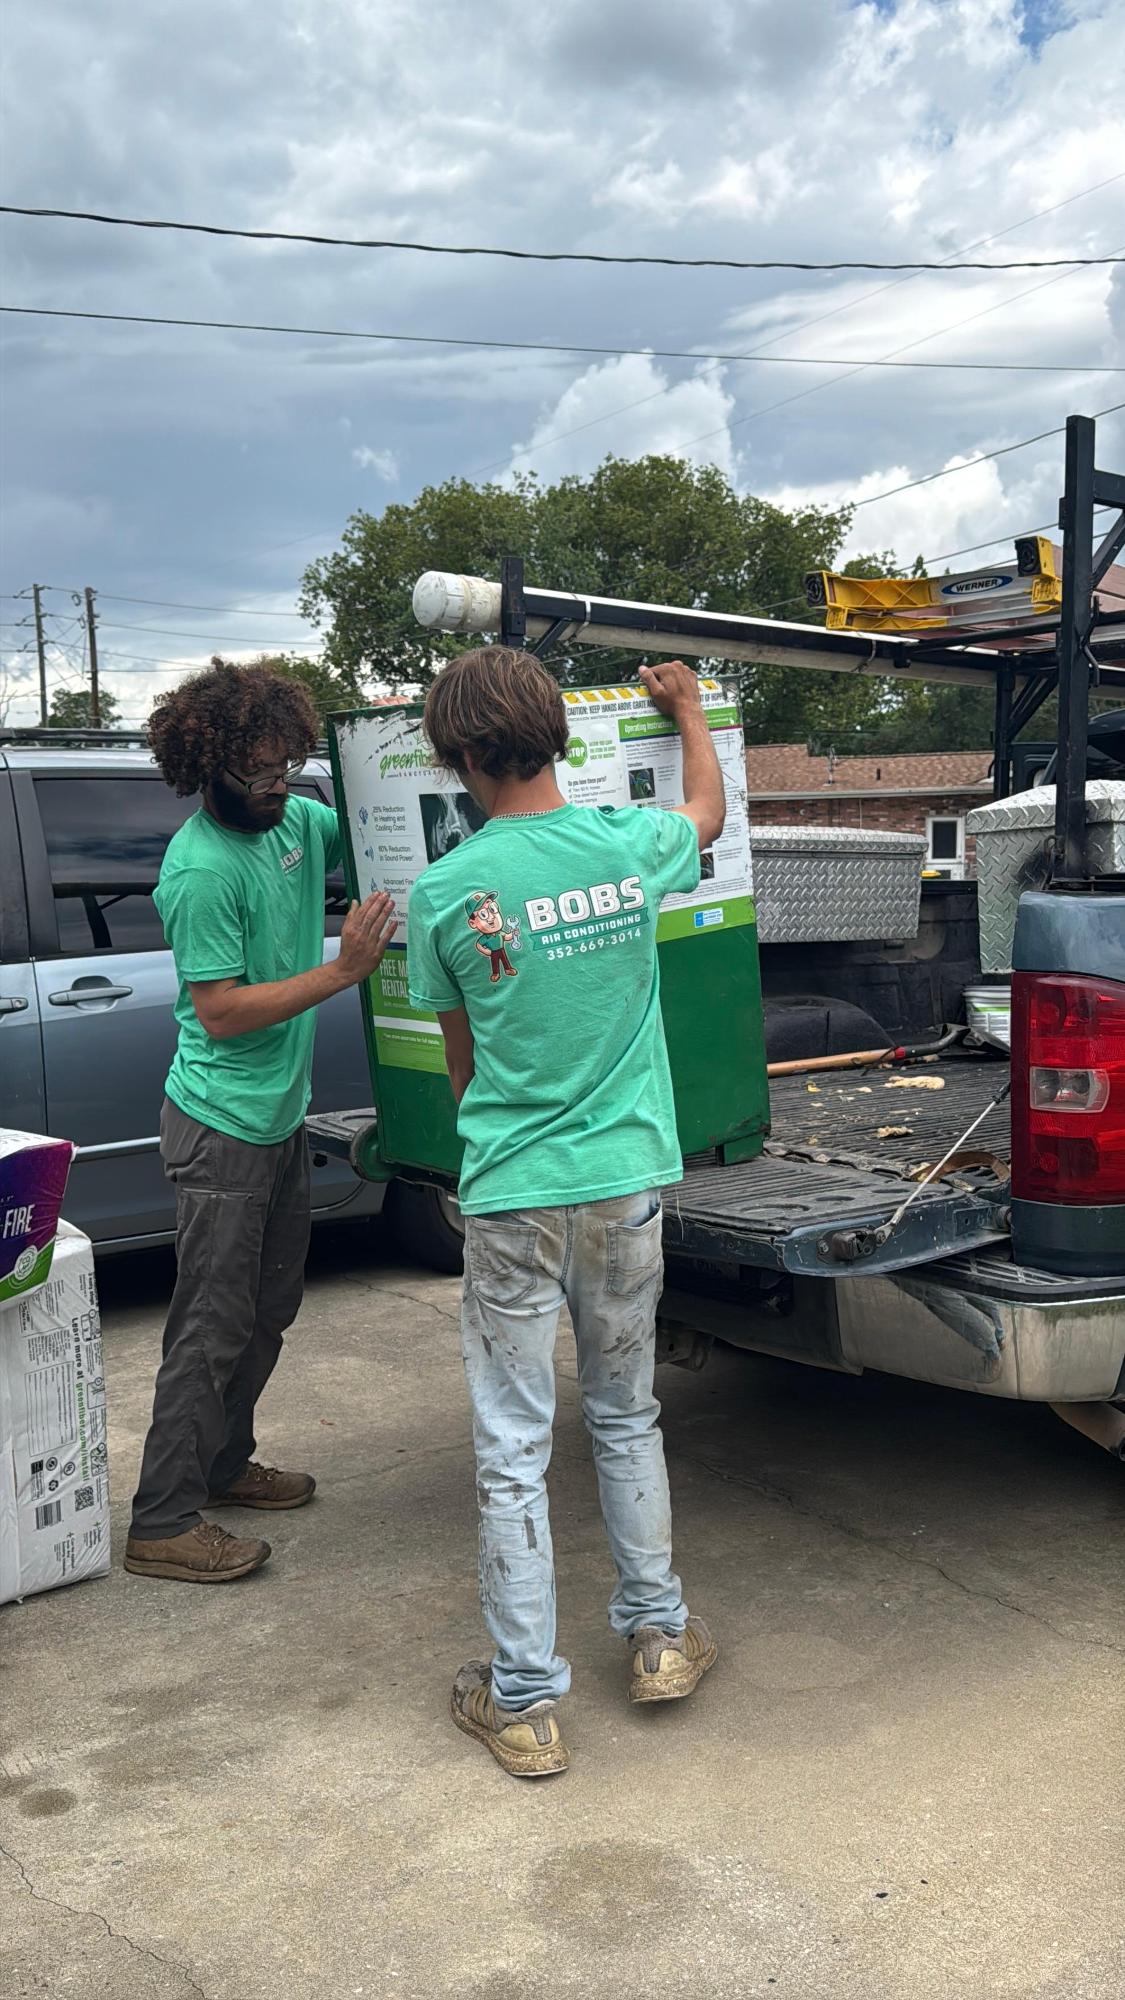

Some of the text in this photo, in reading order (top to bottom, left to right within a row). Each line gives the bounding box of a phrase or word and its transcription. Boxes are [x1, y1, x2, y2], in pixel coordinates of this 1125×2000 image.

[956, 579, 998, 592] WERNER
[566, 706, 588, 716] CAUTION:
[589, 704, 600, 714] KEEP
[601, 703, 617, 713] HANDS
[617, 701, 632, 711] ABOVE
[632, 700, 646, 710] GRATE
[624, 721, 673, 734] Operating Instructions
[382, 805, 406, 813] Reduction
[375, 823, 406, 833] Cooling Costs
[379, 815, 397, 824] Heating
[388, 845, 411, 853] Reduction
[524, 874, 645, 932] BOBS
[541, 913, 641, 945] AIR CONDITIONING
[546, 928, 642, 961] 352-669-3014
[380, 958, 397, 977] FREE
[381, 979, 409, 998] RENTAL
[2, 1203, 36, 1240] FIRE
[72, 1317, 90, 1482] Learn more at greenfiber.com/install
